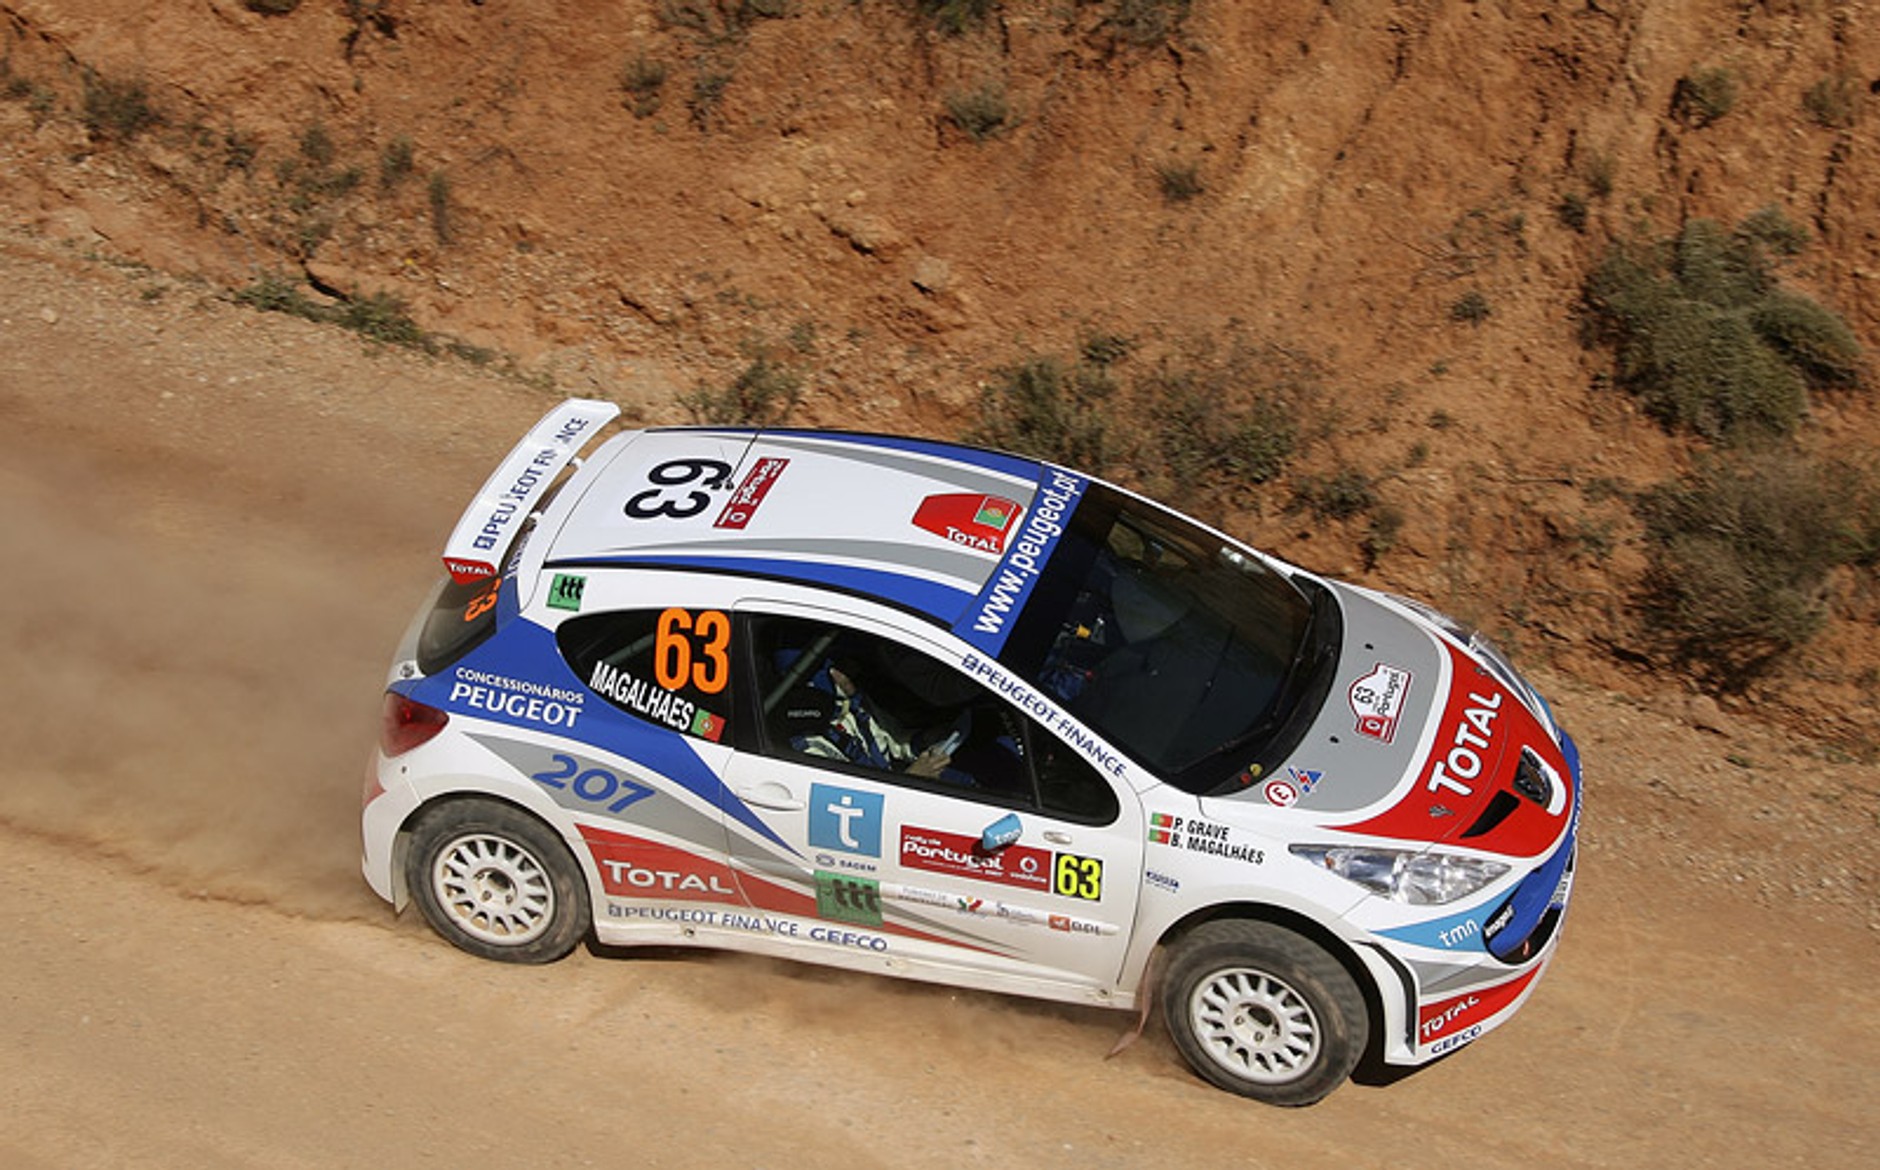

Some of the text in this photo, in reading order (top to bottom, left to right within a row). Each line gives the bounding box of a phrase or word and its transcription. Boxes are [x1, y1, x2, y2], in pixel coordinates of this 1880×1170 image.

[624, 459, 732, 519] 63
[946, 526, 1000, 553] TOTAL
[973, 470, 1082, 634] www.peugeot.pt
[448, 561, 492, 576] TOTAL
[654, 607, 731, 694] 63
[456, 667, 584, 704] CONCESSIONÁRIOS
[1353, 686, 1375, 704] 63
[450, 682, 582, 729] PEUGEOT
[976, 662, 1127, 777] PEUGEOT FINANCE
[1427, 692, 1502, 796] TOTAL
[531, 754, 655, 813] 207
[1171, 833, 1183, 848] B.
[1173, 817, 1230, 842] P. GRAVE
[902, 841, 1004, 870] Portugal
[602, 859, 734, 895] TOTAL
[1057, 855, 1101, 900] 63
[625, 906, 718, 926] PEUGEOT
[1439, 918, 1480, 947] tmn
[809, 927, 888, 952] GEFCO
[1421, 995, 1480, 1037] TOTAL
[1431, 1025, 1482, 1054] GEFCO
